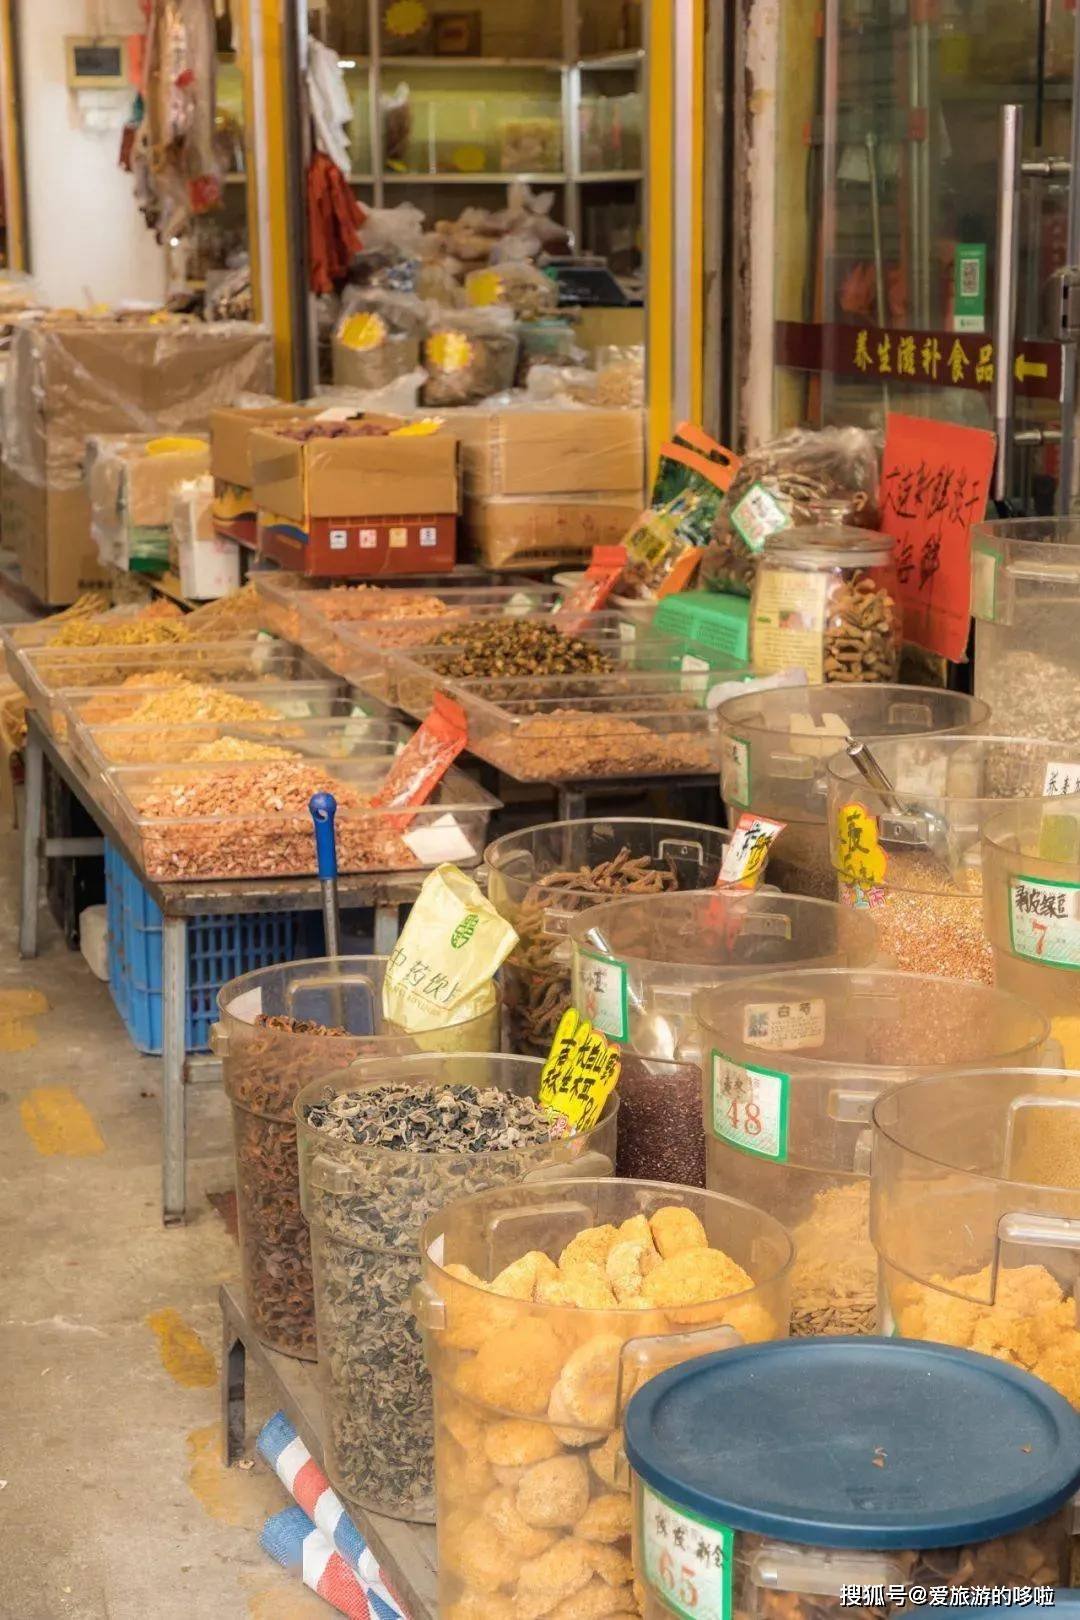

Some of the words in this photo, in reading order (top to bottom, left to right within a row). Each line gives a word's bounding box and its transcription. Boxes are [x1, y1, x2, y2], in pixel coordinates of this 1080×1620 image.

[1032, 919, 1048, 955] 7
[726, 1098, 762, 1136] 48
[657, 1547, 699, 1609] 65
